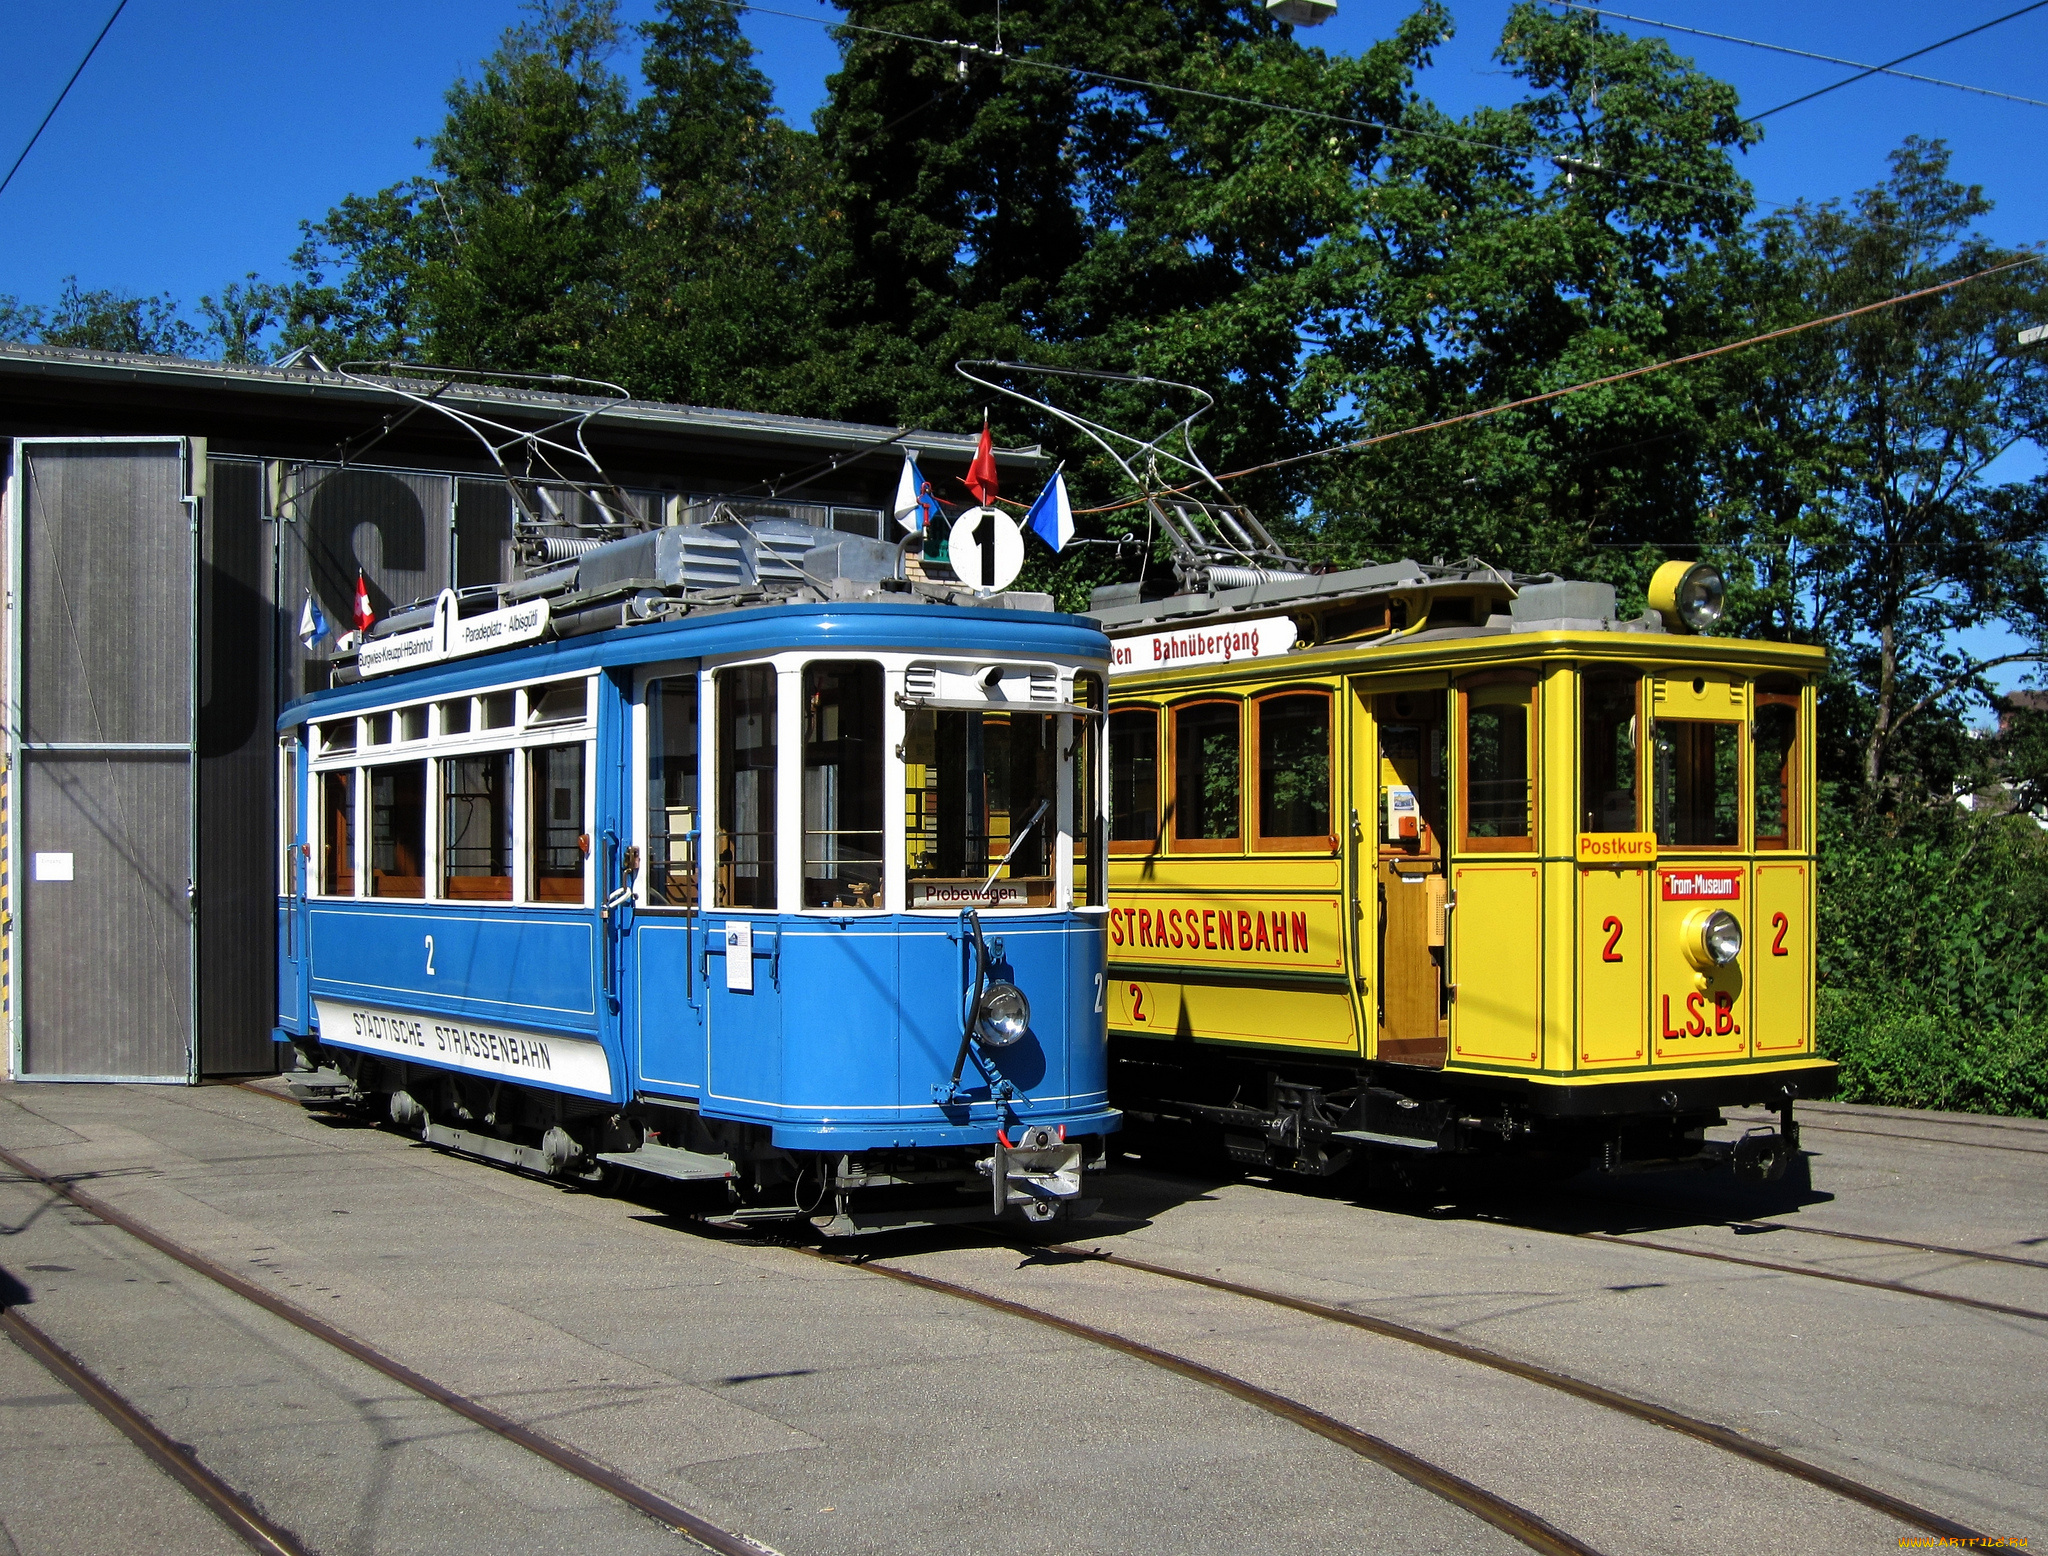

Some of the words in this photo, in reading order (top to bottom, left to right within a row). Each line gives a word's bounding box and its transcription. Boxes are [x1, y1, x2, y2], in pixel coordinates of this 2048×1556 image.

[972, 514, 995, 586] 1
[440, 595, 448, 652] 1
[465, 620, 502, 643] Paradeplatz
[1153, 627, 1259, 661] Bahnübergang
[1580, 837, 1652, 855] Postkurs
[925, 885, 1017, 905] Probewagen
[1669, 874, 1732, 895] Tram-Museum
[1110, 907, 1309, 954] STRASSENBAHN
[1602, 915, 1623, 963] 2
[1771, 911, 1788, 957] 2
[424, 934, 436, 976] 2
[1094, 972, 1103, 1013] 2
[1129, 982, 1146, 1021] 2
[1662, 990, 1741, 1039] L.S.B.
[353, 1010, 425, 1048] STÄDTISCHE
[434, 1025, 551, 1071] STRASSENBAHN
